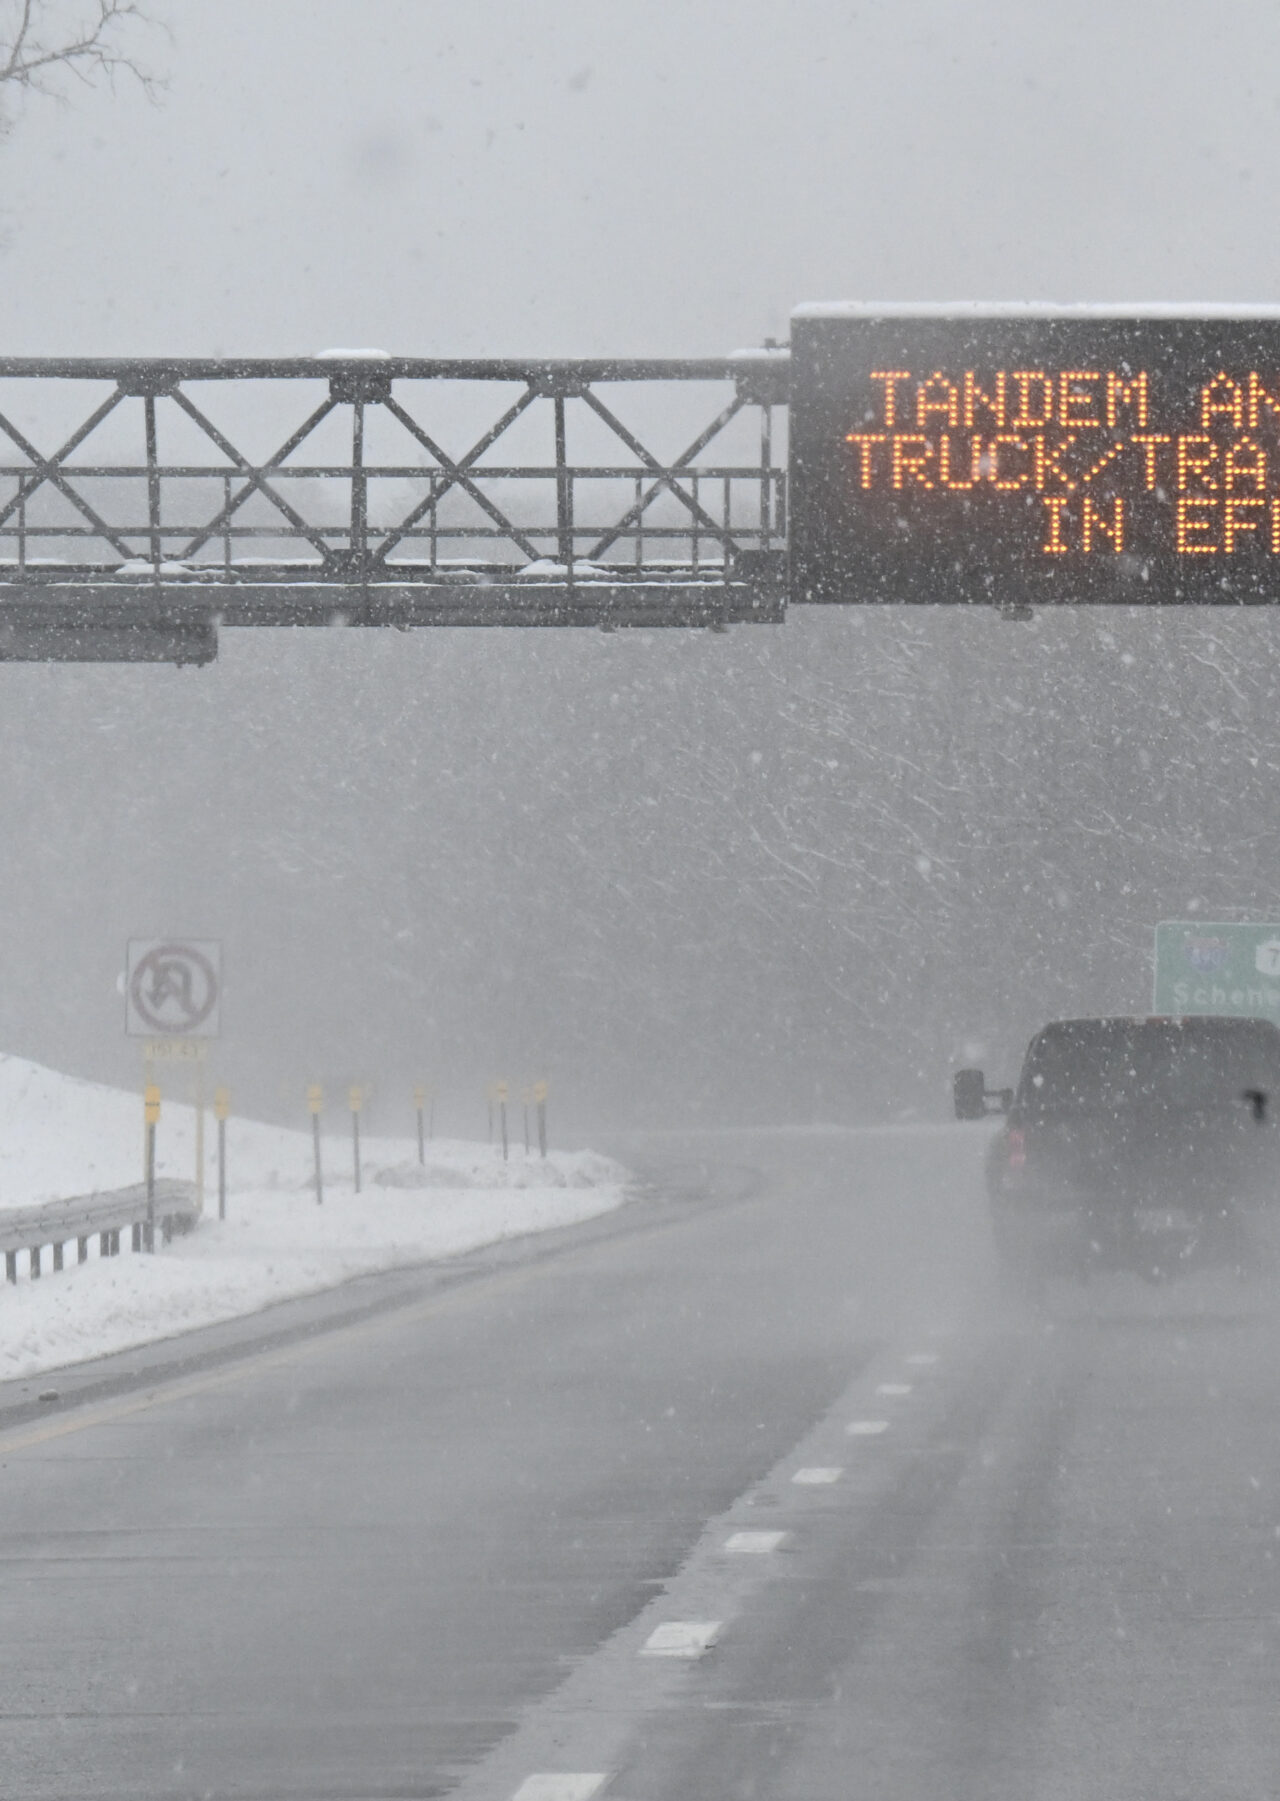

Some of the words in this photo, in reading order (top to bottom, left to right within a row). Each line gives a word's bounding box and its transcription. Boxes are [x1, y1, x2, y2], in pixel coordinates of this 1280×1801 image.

[870, 371, 1148, 428] TANDEM
[1044, 498, 1123, 552] IN
[1268, 948, 1280, 967] 7
